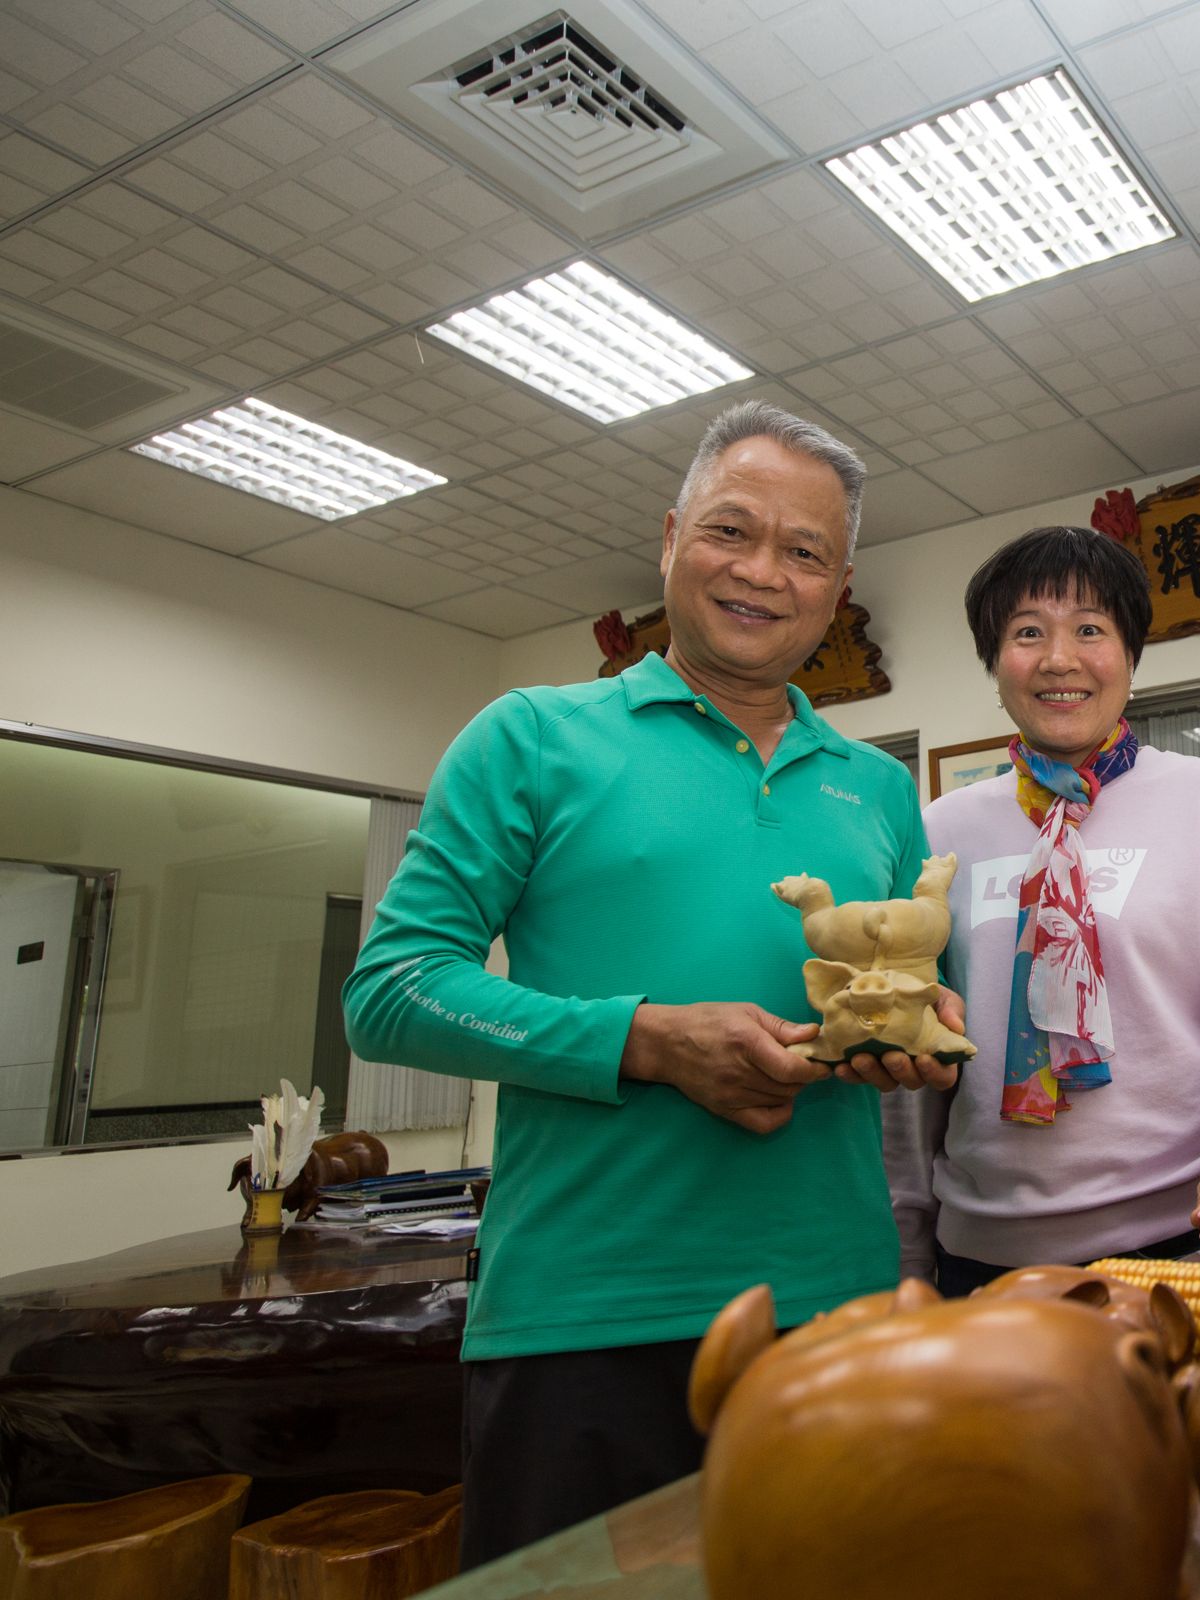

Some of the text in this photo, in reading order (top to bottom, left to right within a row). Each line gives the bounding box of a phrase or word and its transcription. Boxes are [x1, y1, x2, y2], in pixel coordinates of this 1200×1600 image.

[429, 999, 446, 1016] be
[445, 1011, 456, 1022] a
[459, 1012, 529, 1042] Covidiot
